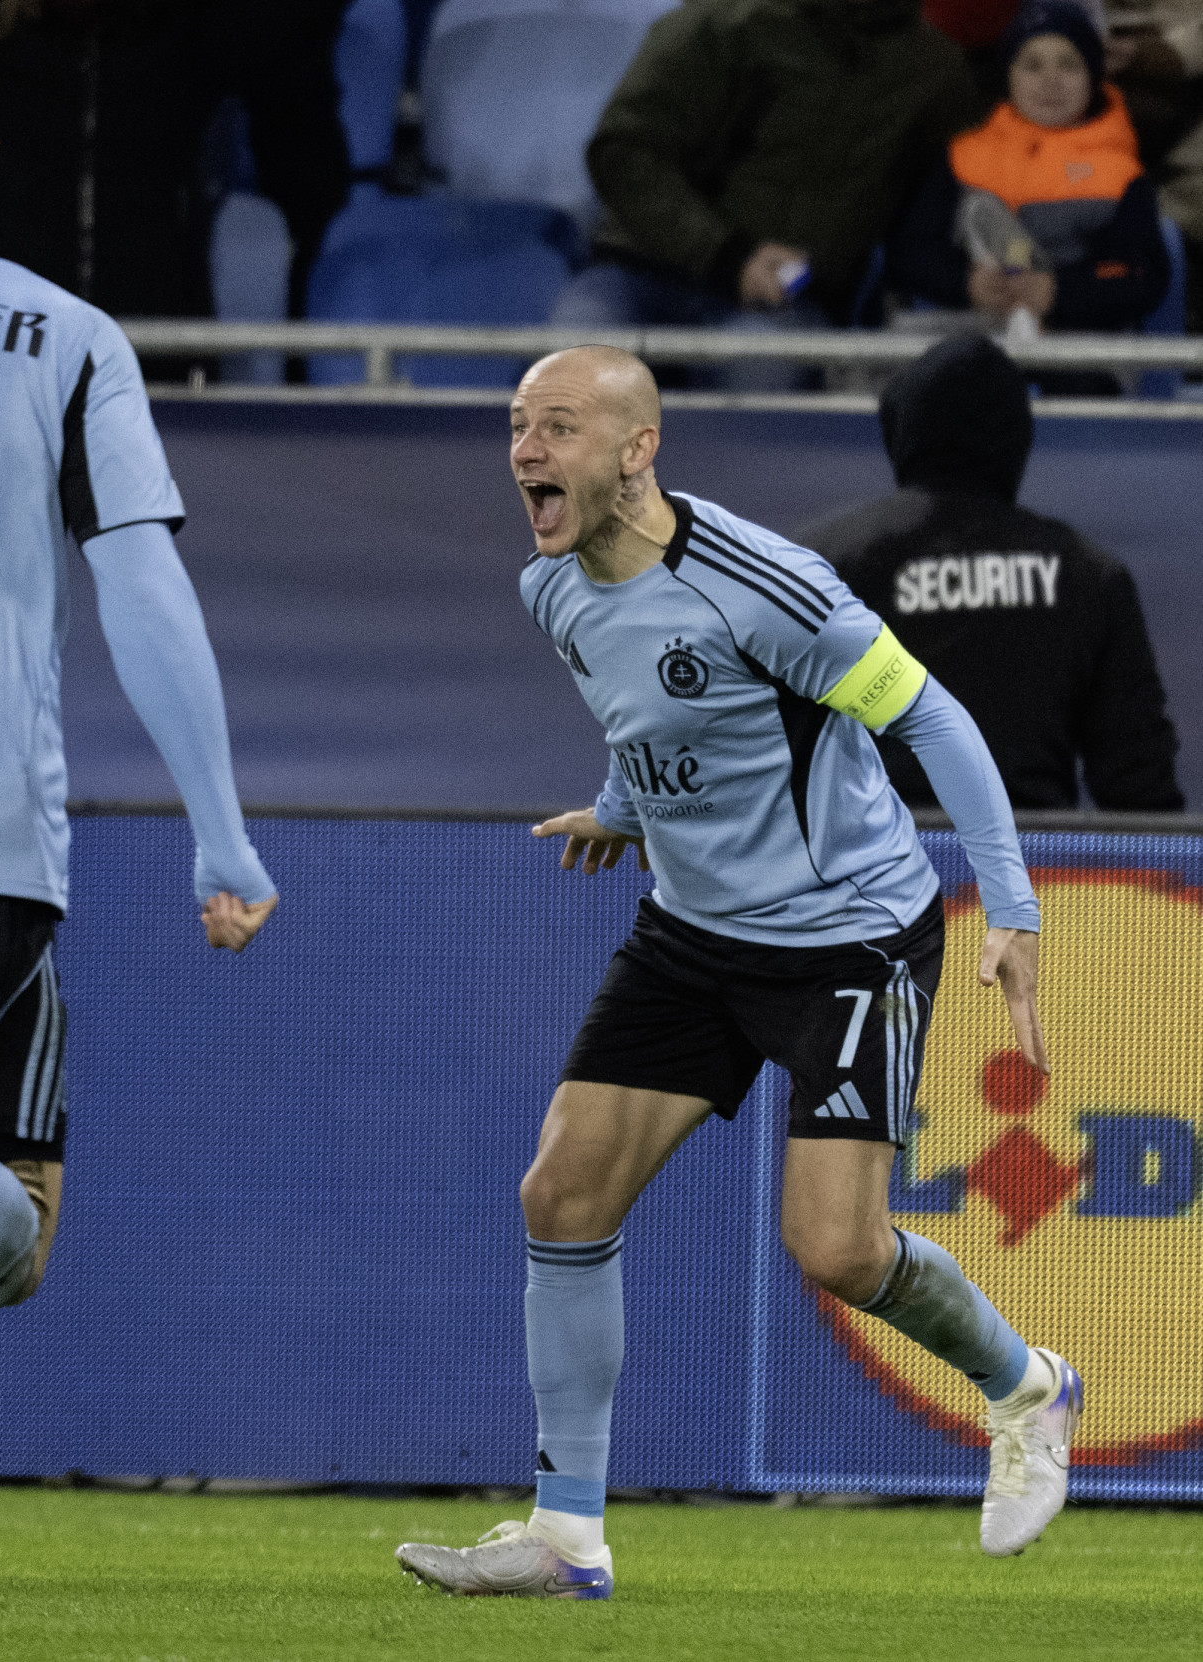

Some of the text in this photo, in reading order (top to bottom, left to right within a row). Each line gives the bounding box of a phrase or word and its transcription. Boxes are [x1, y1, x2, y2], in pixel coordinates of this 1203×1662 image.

[896, 553, 1061, 615] SECURITY
[860, 655, 904, 707] RESPECT
[835, 989, 873, 1068] 7
